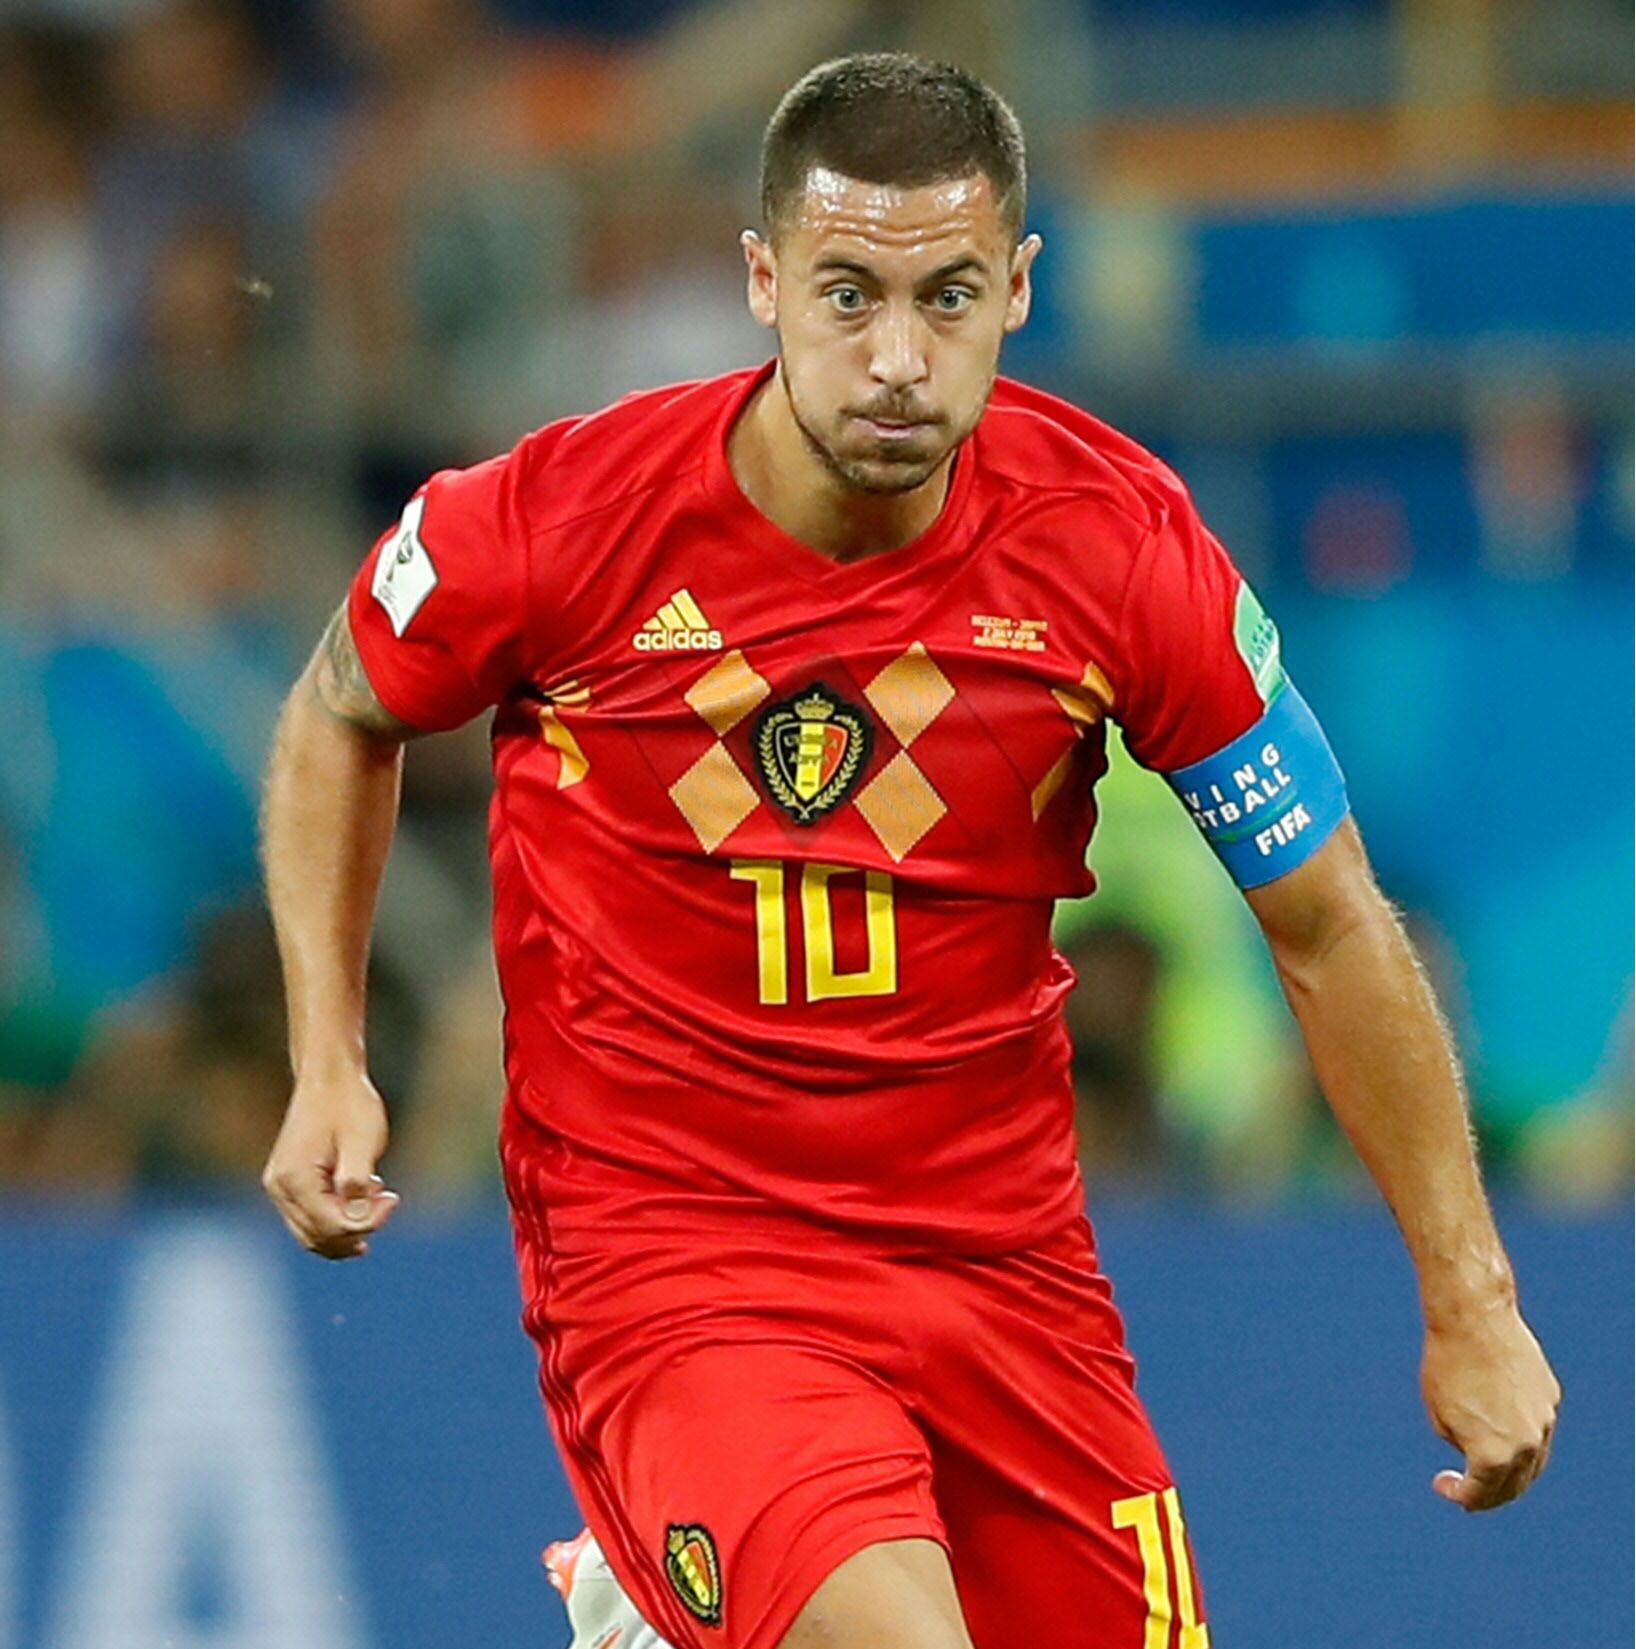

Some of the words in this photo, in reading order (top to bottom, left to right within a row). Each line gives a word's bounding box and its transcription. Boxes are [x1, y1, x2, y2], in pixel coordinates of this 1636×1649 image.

[632, 628, 723, 651] adidas
[1255, 802, 1312, 856] FIFA
[729, 859, 897, 1005] 10
